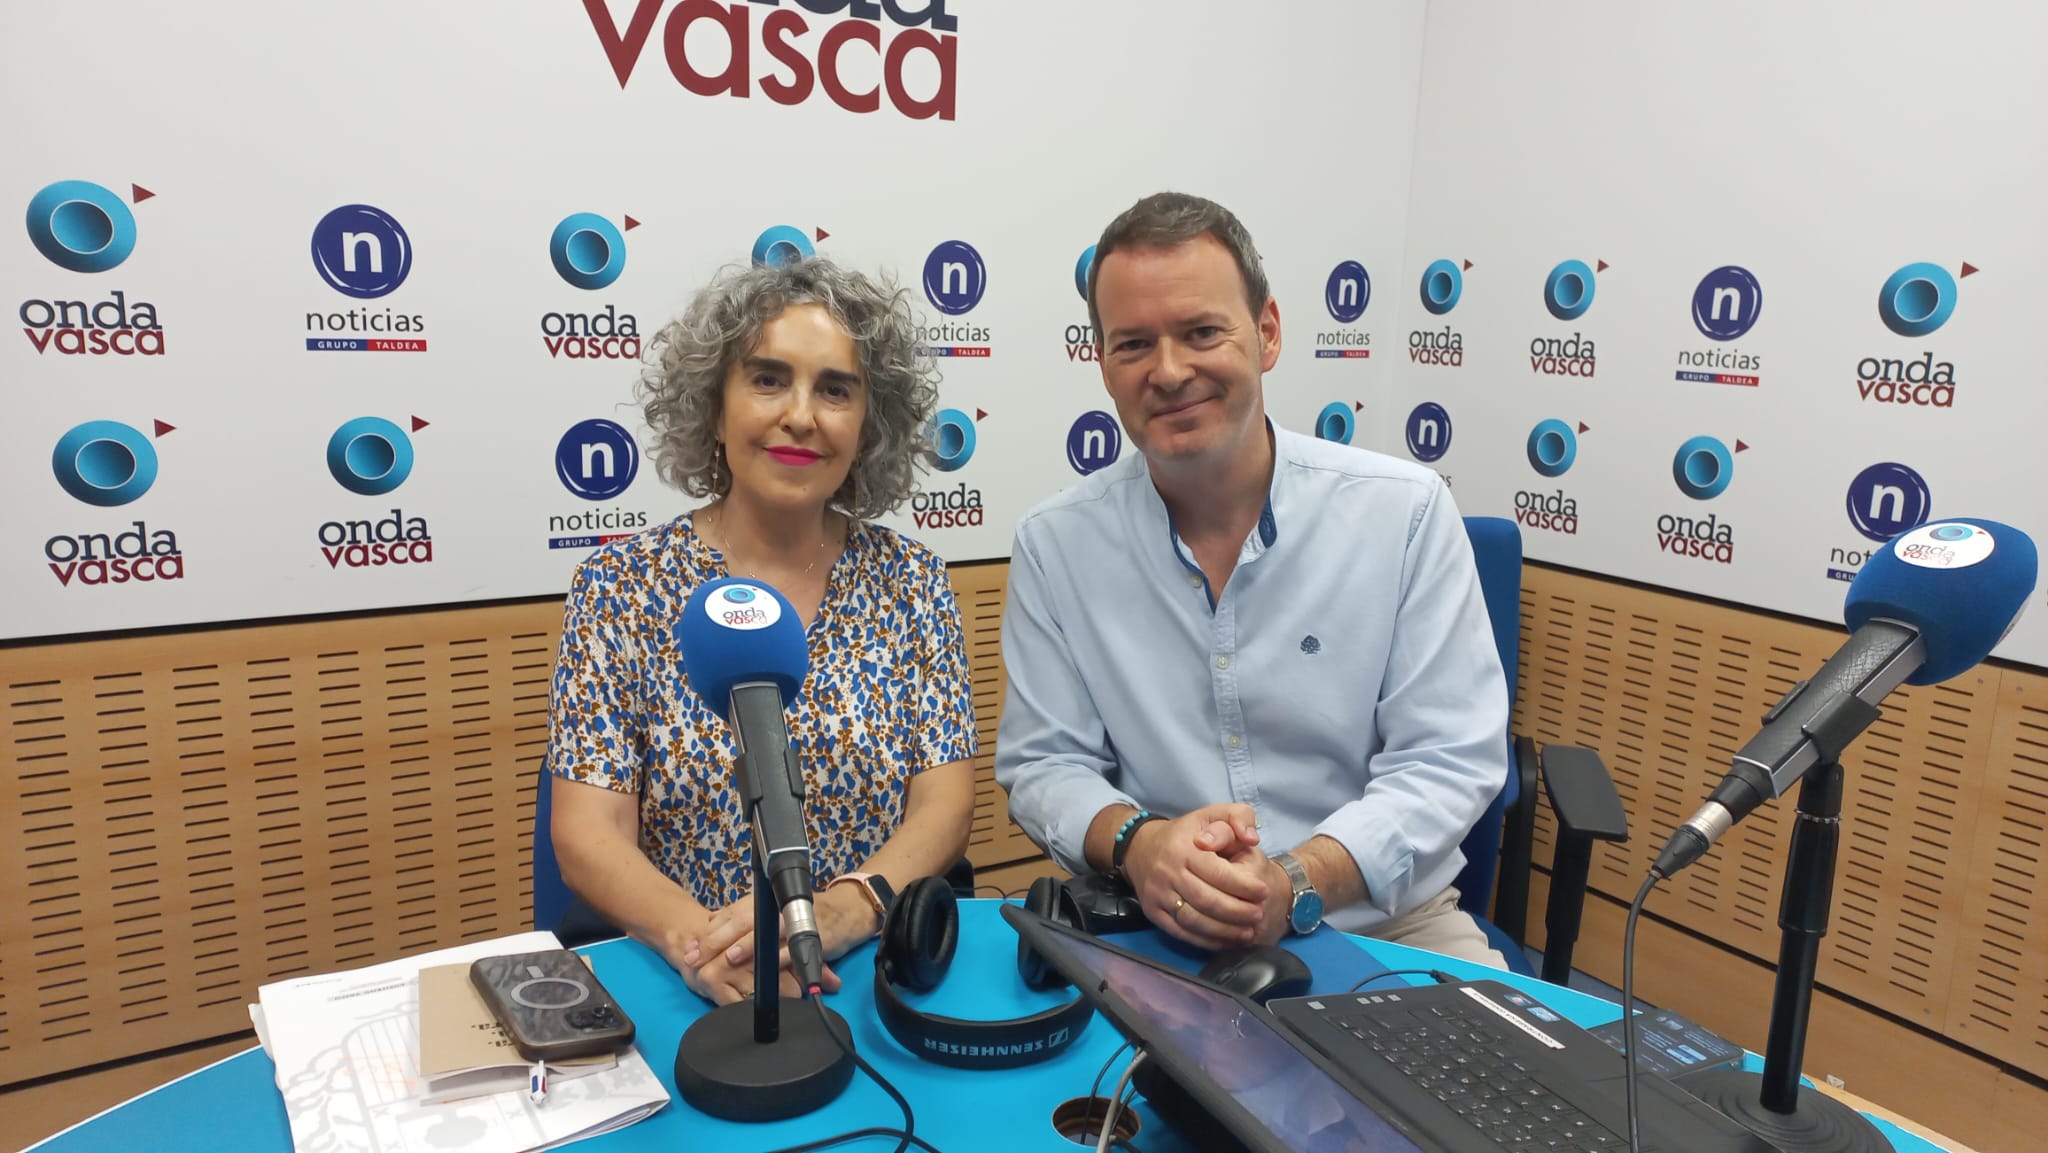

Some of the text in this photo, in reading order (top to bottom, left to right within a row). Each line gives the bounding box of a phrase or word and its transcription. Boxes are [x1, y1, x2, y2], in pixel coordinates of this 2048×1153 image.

[581, 0, 957, 121] vasca
[19, 291, 162, 330] onda
[306, 307, 424, 332] noticias
[541, 305, 640, 338] onda
[24, 328, 165, 356] vasca
[915, 322, 990, 341] noticias
[1065, 325, 1096, 345] on
[1316, 329, 1370, 345] noticias
[1409, 326, 1463, 350] onda
[317, 341, 419, 350] GRUPO TALDEA
[543, 336, 641, 359] vasca
[1409, 347, 1463, 367] vasca
[1530, 333, 1595, 360] onda
[1530, 355, 1595, 377] vasca
[1678, 349, 1761, 370] noticias
[1857, 352, 1955, 385] onda
[1683, 373, 1753, 384] GRUPO TALDEA
[1857, 380, 1955, 408] vasca
[912, 482, 983, 512] onda
[1514, 490, 1578, 517] onda
[318, 509, 431, 547] onda
[549, 507, 648, 532] noticias
[912, 508, 983, 530] vasca
[1514, 508, 1578, 534] vasca
[1657, 514, 1733, 545] onda
[45, 521, 181, 563] onda
[558, 538, 591, 547] GRUPO
[1656, 533, 1733, 564] vasca
[1906, 543, 1956, 558] onda
[320, 541, 433, 569] vasca
[48, 555, 184, 587] vasca
[722, 607, 766, 620] onda
[724, 616, 768, 625] vasca
[924, 1037, 1044, 1057] SENNHEISER
